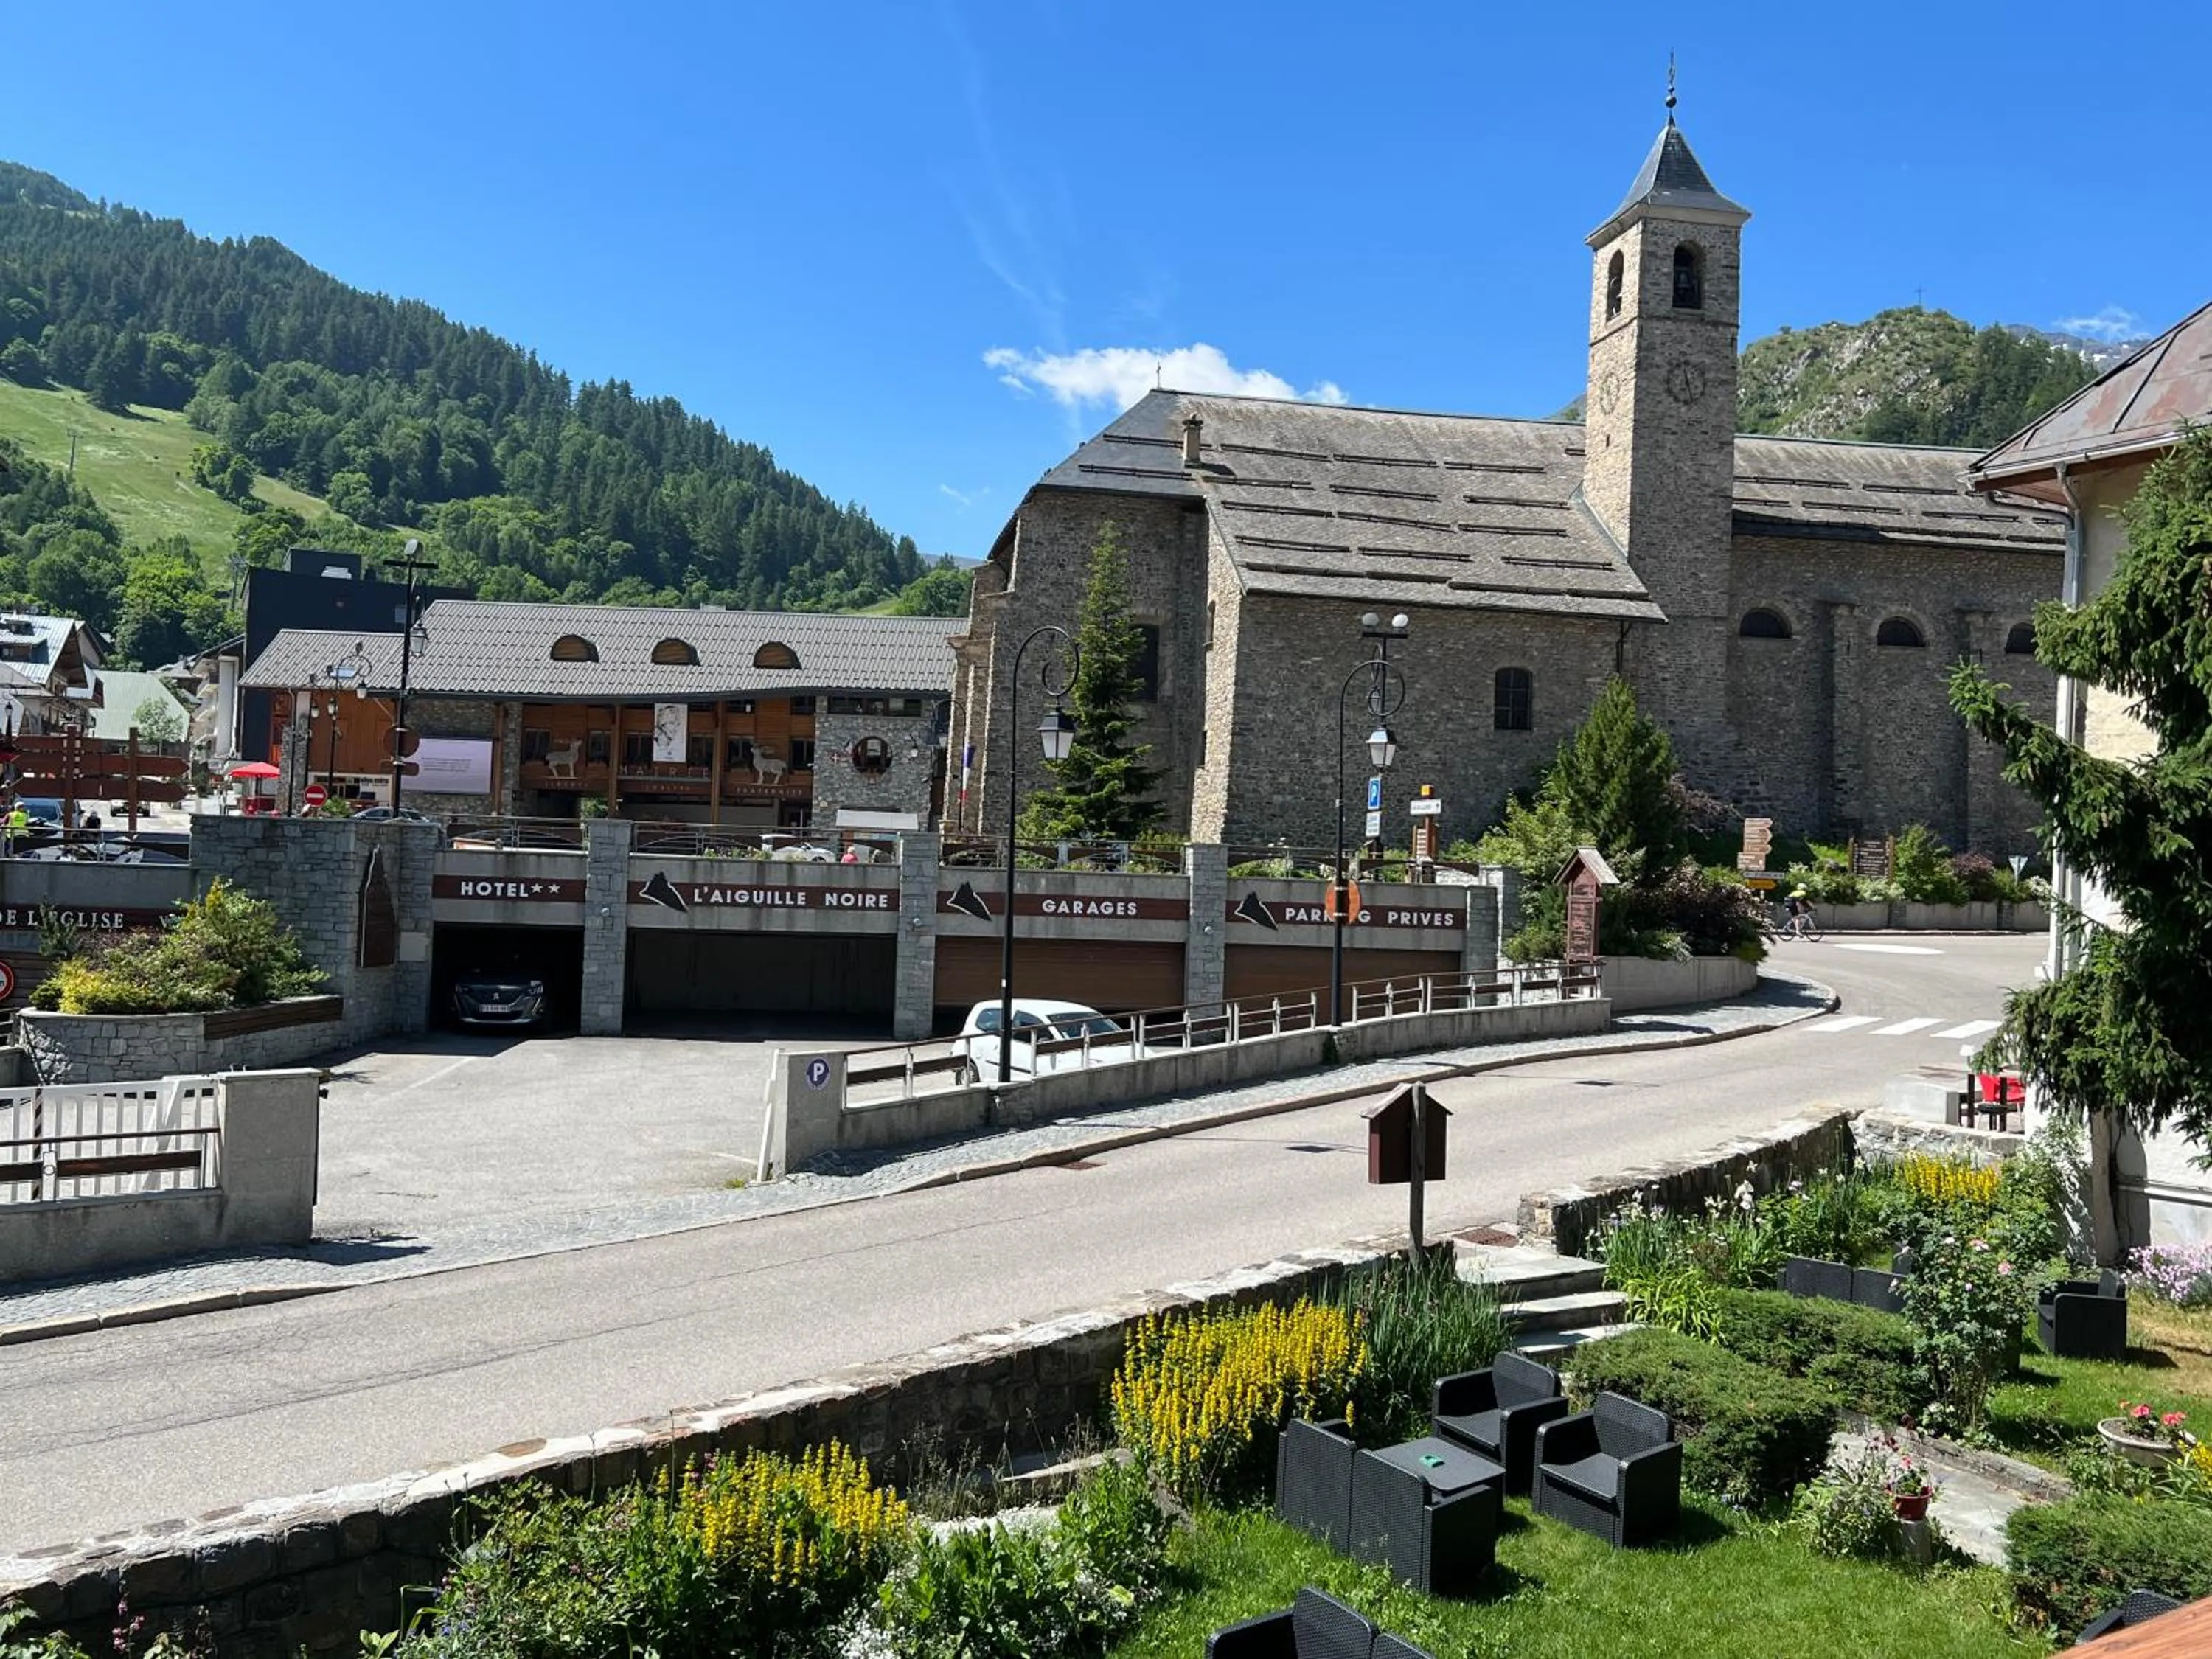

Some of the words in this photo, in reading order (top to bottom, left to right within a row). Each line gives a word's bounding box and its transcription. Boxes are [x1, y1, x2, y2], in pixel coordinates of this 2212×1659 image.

[461, 881, 529, 897] HOTEL
[693, 887, 807, 905] L'AIGUILLE
[824, 892, 888, 908] NOIRE
[1042, 899, 1138, 915] GARAGES
[1285, 908, 1371, 923] PARKG
[1388, 911, 1454, 926] PRIVES
[813, 1062, 825, 1082] P
